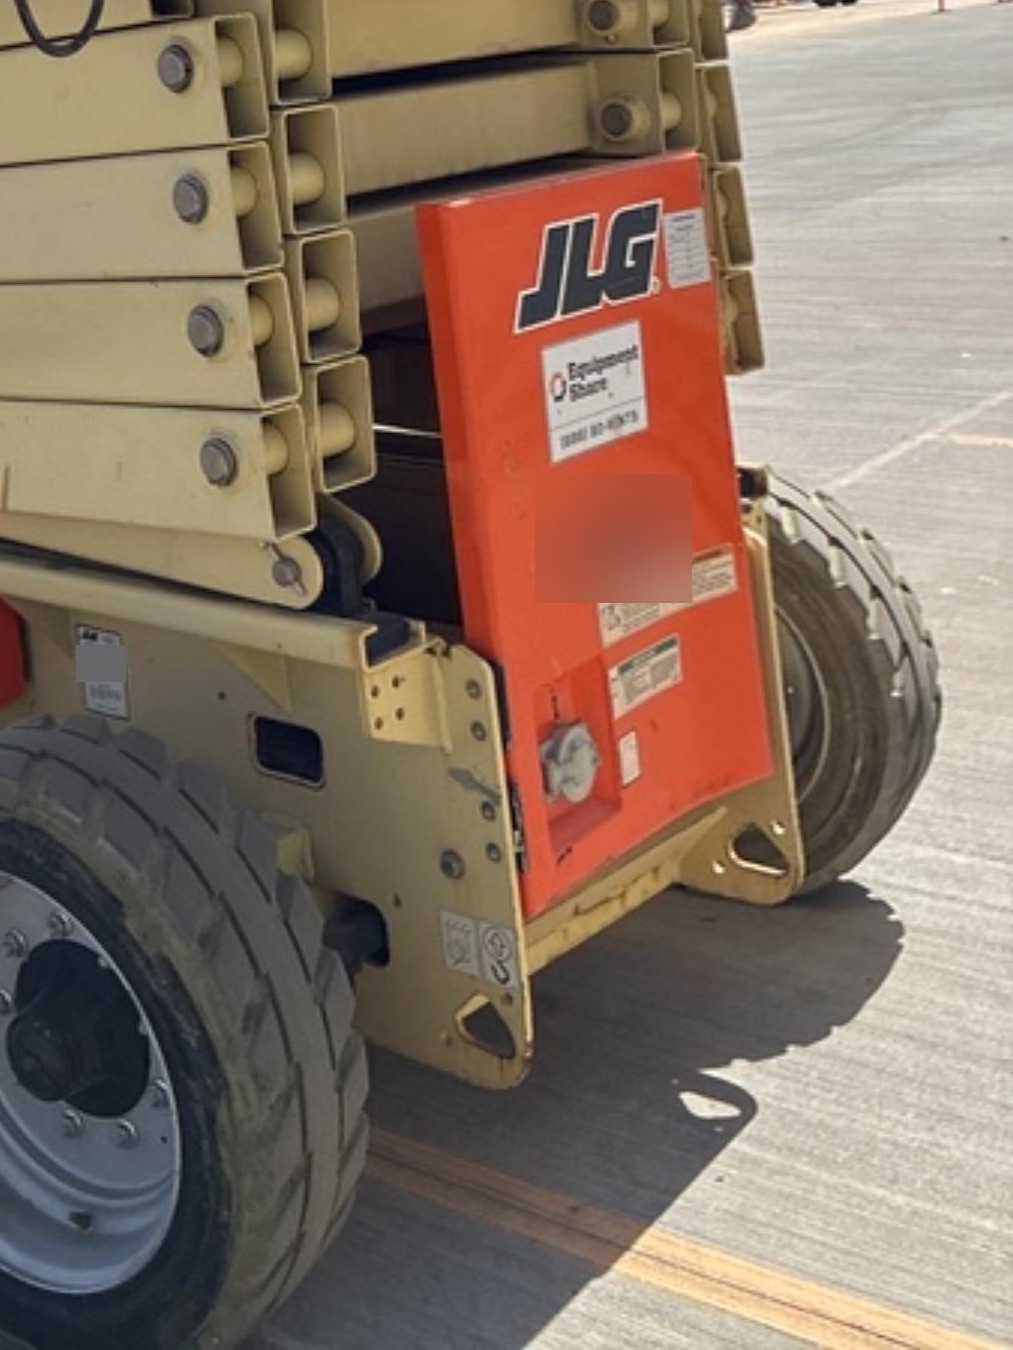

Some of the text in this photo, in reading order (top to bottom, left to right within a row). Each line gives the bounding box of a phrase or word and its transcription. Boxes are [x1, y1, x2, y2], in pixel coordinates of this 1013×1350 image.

[514, 198, 663, 335] JLG
[567, 343, 640, 382] Equipment
[568, 376, 608, 404] Share
